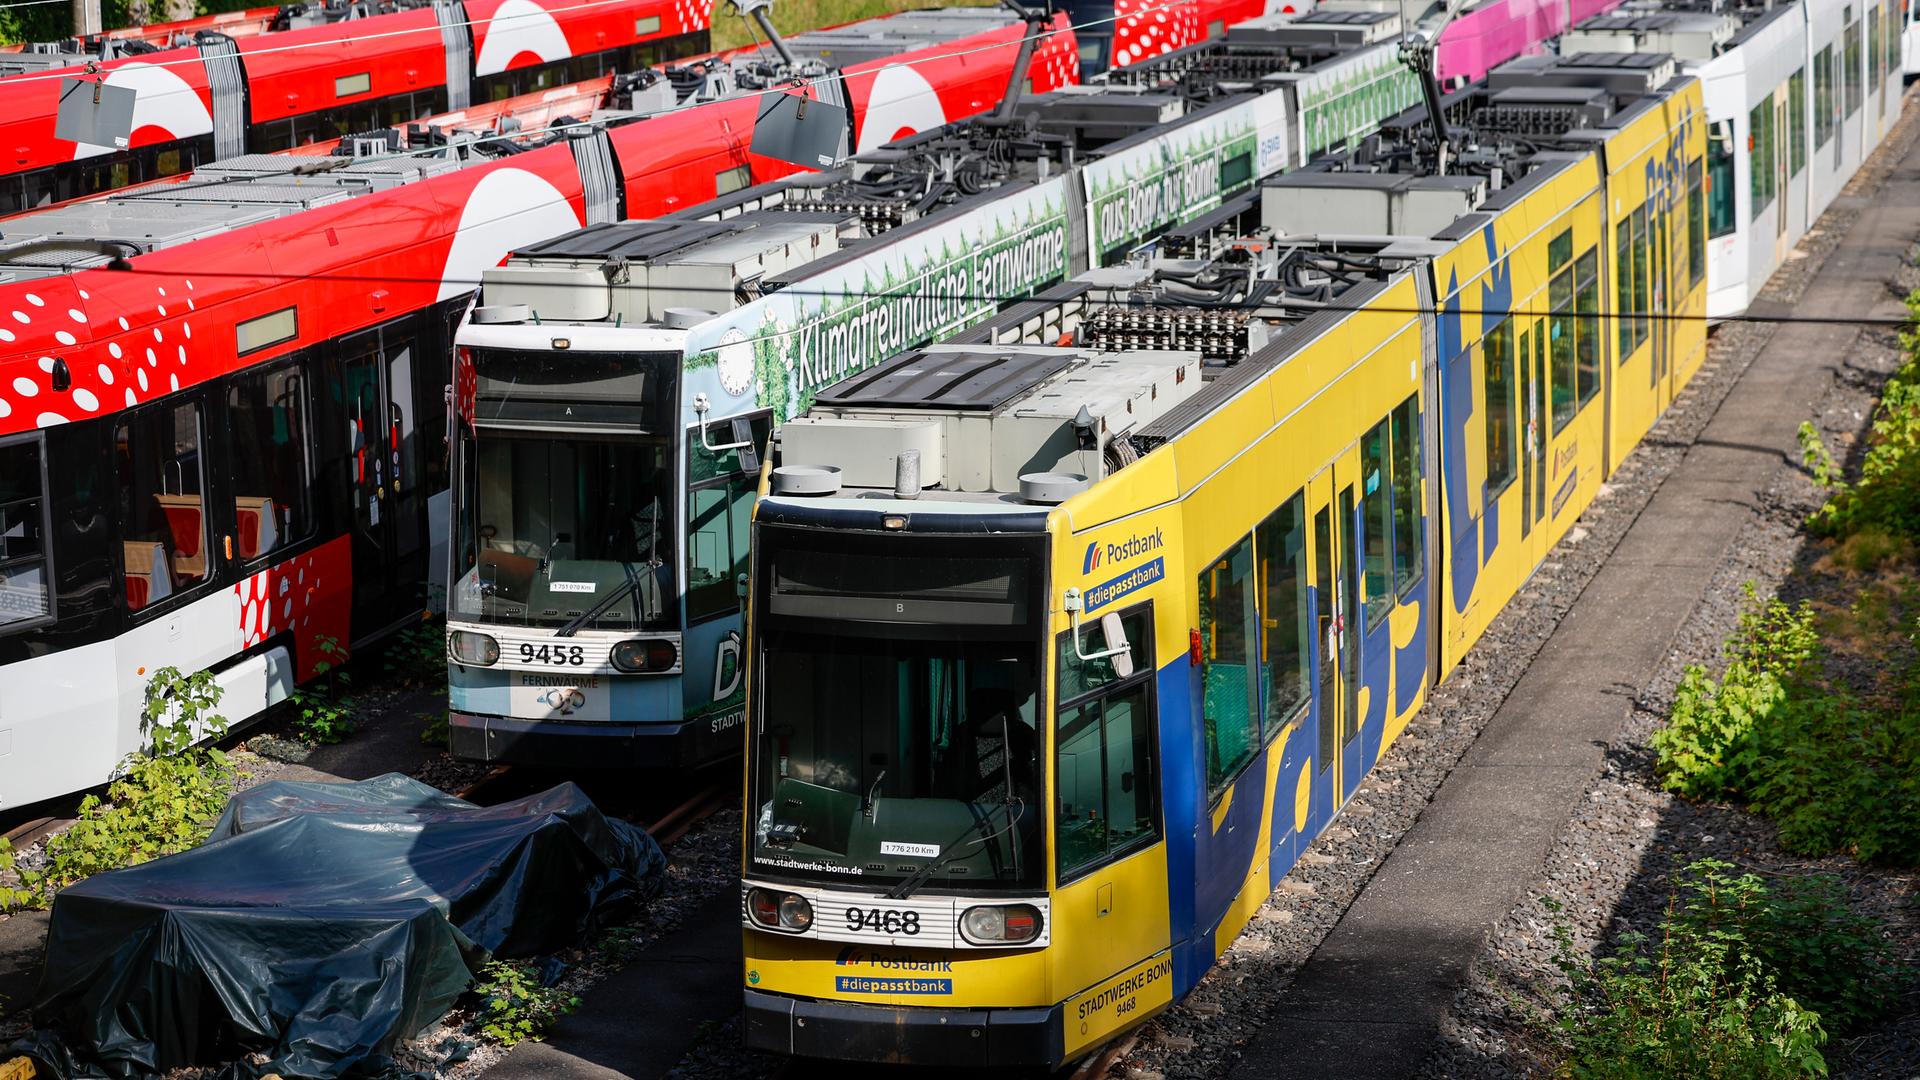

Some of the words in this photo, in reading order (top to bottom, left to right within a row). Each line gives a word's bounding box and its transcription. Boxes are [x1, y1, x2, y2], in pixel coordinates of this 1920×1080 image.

[799, 260, 967, 391] Klimafreundliche
[973, 225, 1065, 309] Fernwärme
[1101, 198, 1125, 245] aus
[565, 407, 572, 415] A
[1107, 526, 1164, 565] Postbank
[1088, 561, 1160, 608] #diepasstbank
[896, 603, 904, 613] B
[520, 643, 584, 666] 9458
[522, 673, 598, 689] FERNWÄRME
[885, 844, 890, 852] 1
[891, 845, 905, 853] 776
[921, 846, 934, 854] Km
[754, 856, 863, 876] www.stadtwerke-bonn.de
[845, 907, 920, 935] 9468
[870, 952, 953, 973] Postbank
[842, 978, 946, 992] #diepasstbank
[1079, 973, 1145, 1019] STADTWERKE
[1146, 959, 1173, 984] BONN
[1116, 997, 1136, 1018] 9468
